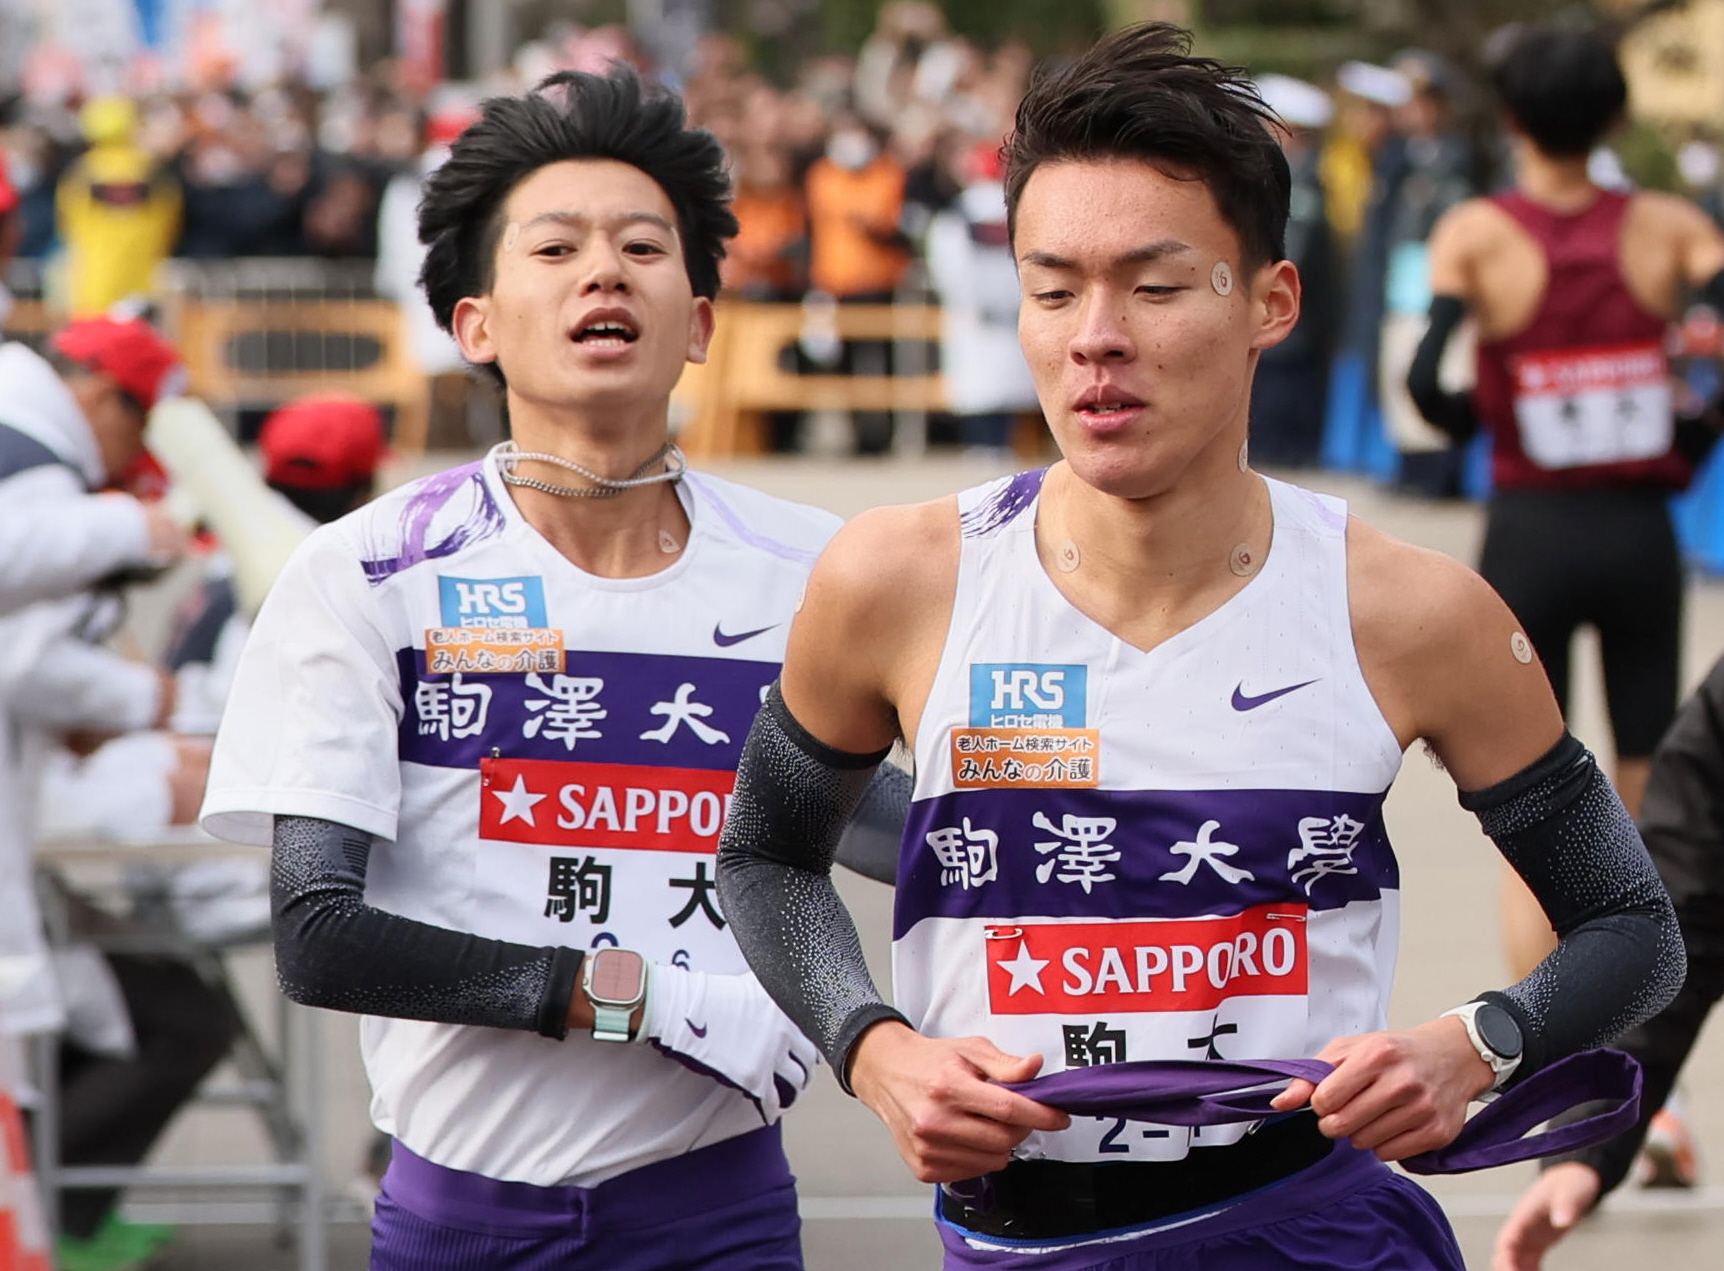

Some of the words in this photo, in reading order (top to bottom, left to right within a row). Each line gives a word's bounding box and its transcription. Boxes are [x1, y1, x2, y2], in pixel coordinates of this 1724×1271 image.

[455, 582, 526, 614] HRS
[432, 631, 556, 645] 老人ホーム検索サイト
[432, 650, 558, 672] みんなの介護
[991, 670, 1064, 710] HRS
[415, 671, 773, 751] 駒澤大
[957, 736, 1093, 752] 老人ホーム検索サイト
[959, 757, 1092, 781] みんなの介護
[557, 783, 733, 837] SAPPO
[1062, 927, 1296, 996] SAPPORO
